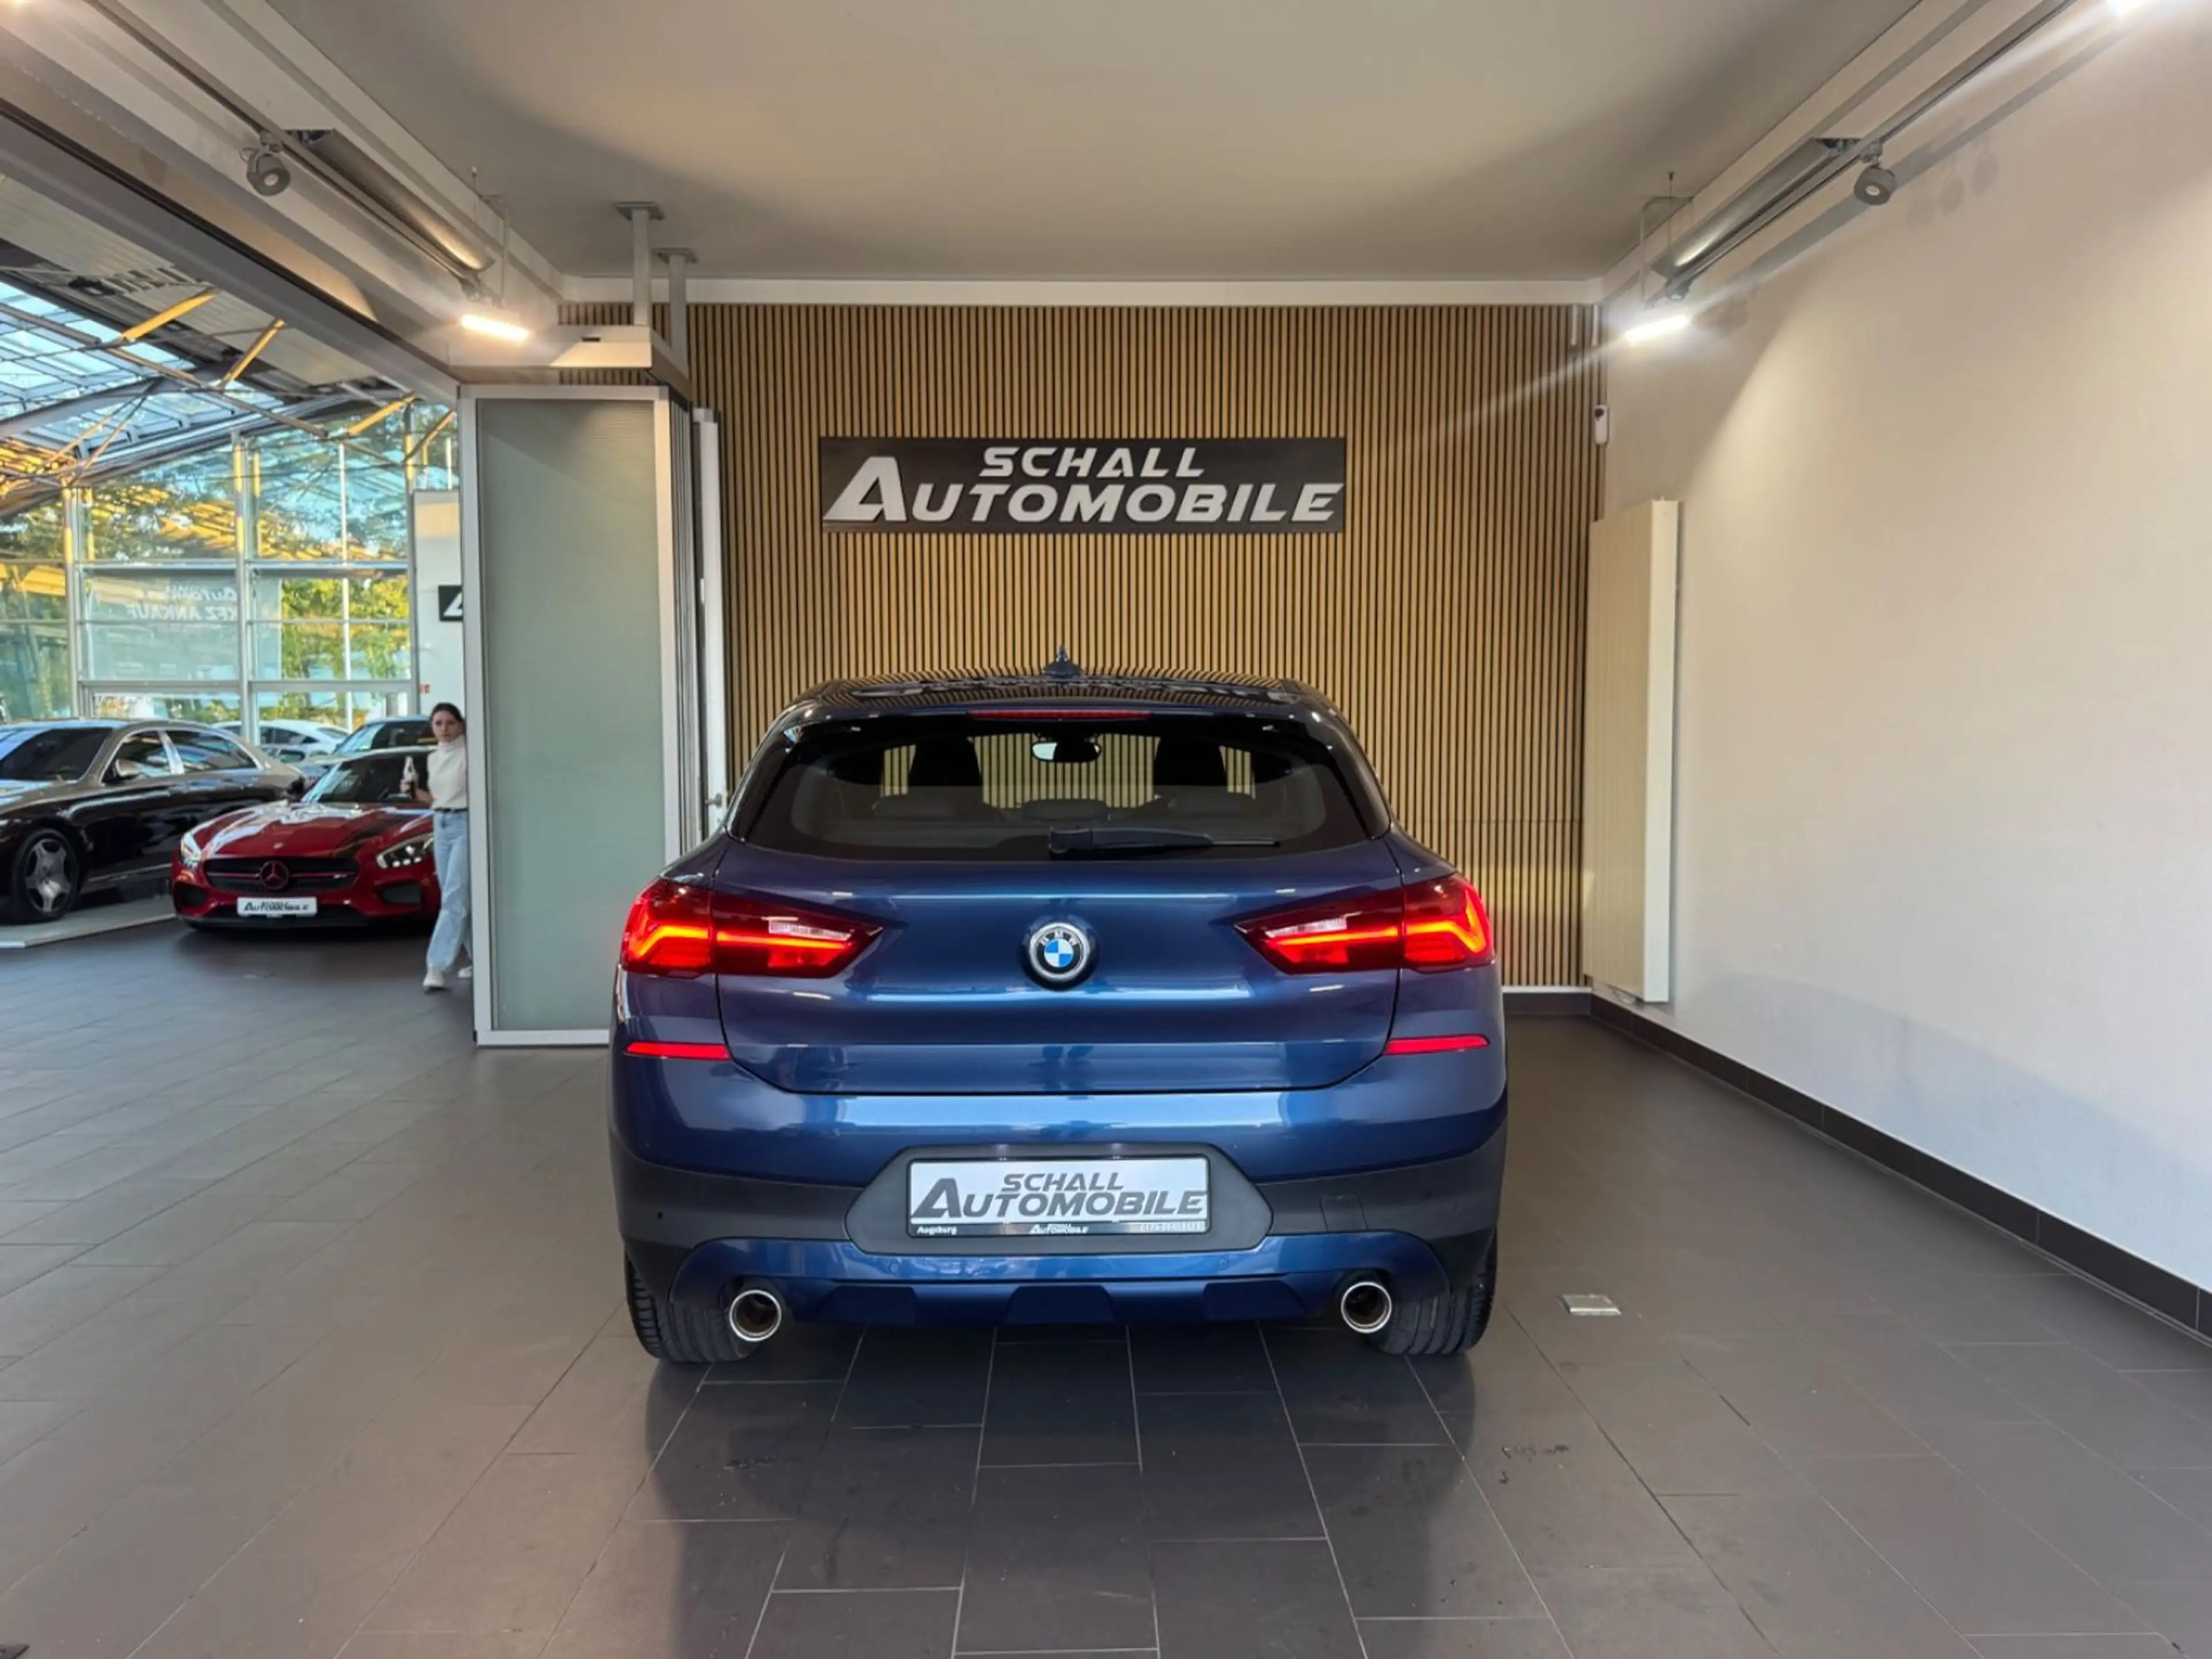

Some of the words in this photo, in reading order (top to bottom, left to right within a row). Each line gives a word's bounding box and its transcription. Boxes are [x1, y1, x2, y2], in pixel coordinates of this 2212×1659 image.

[979, 447, 1205, 478] SCHALL
[823, 456, 1344, 523] AUTOMOBILE
[911, 1178, 1207, 1219] AUTOMOBILE
[1001, 1172, 1124, 1192] SCHALL
